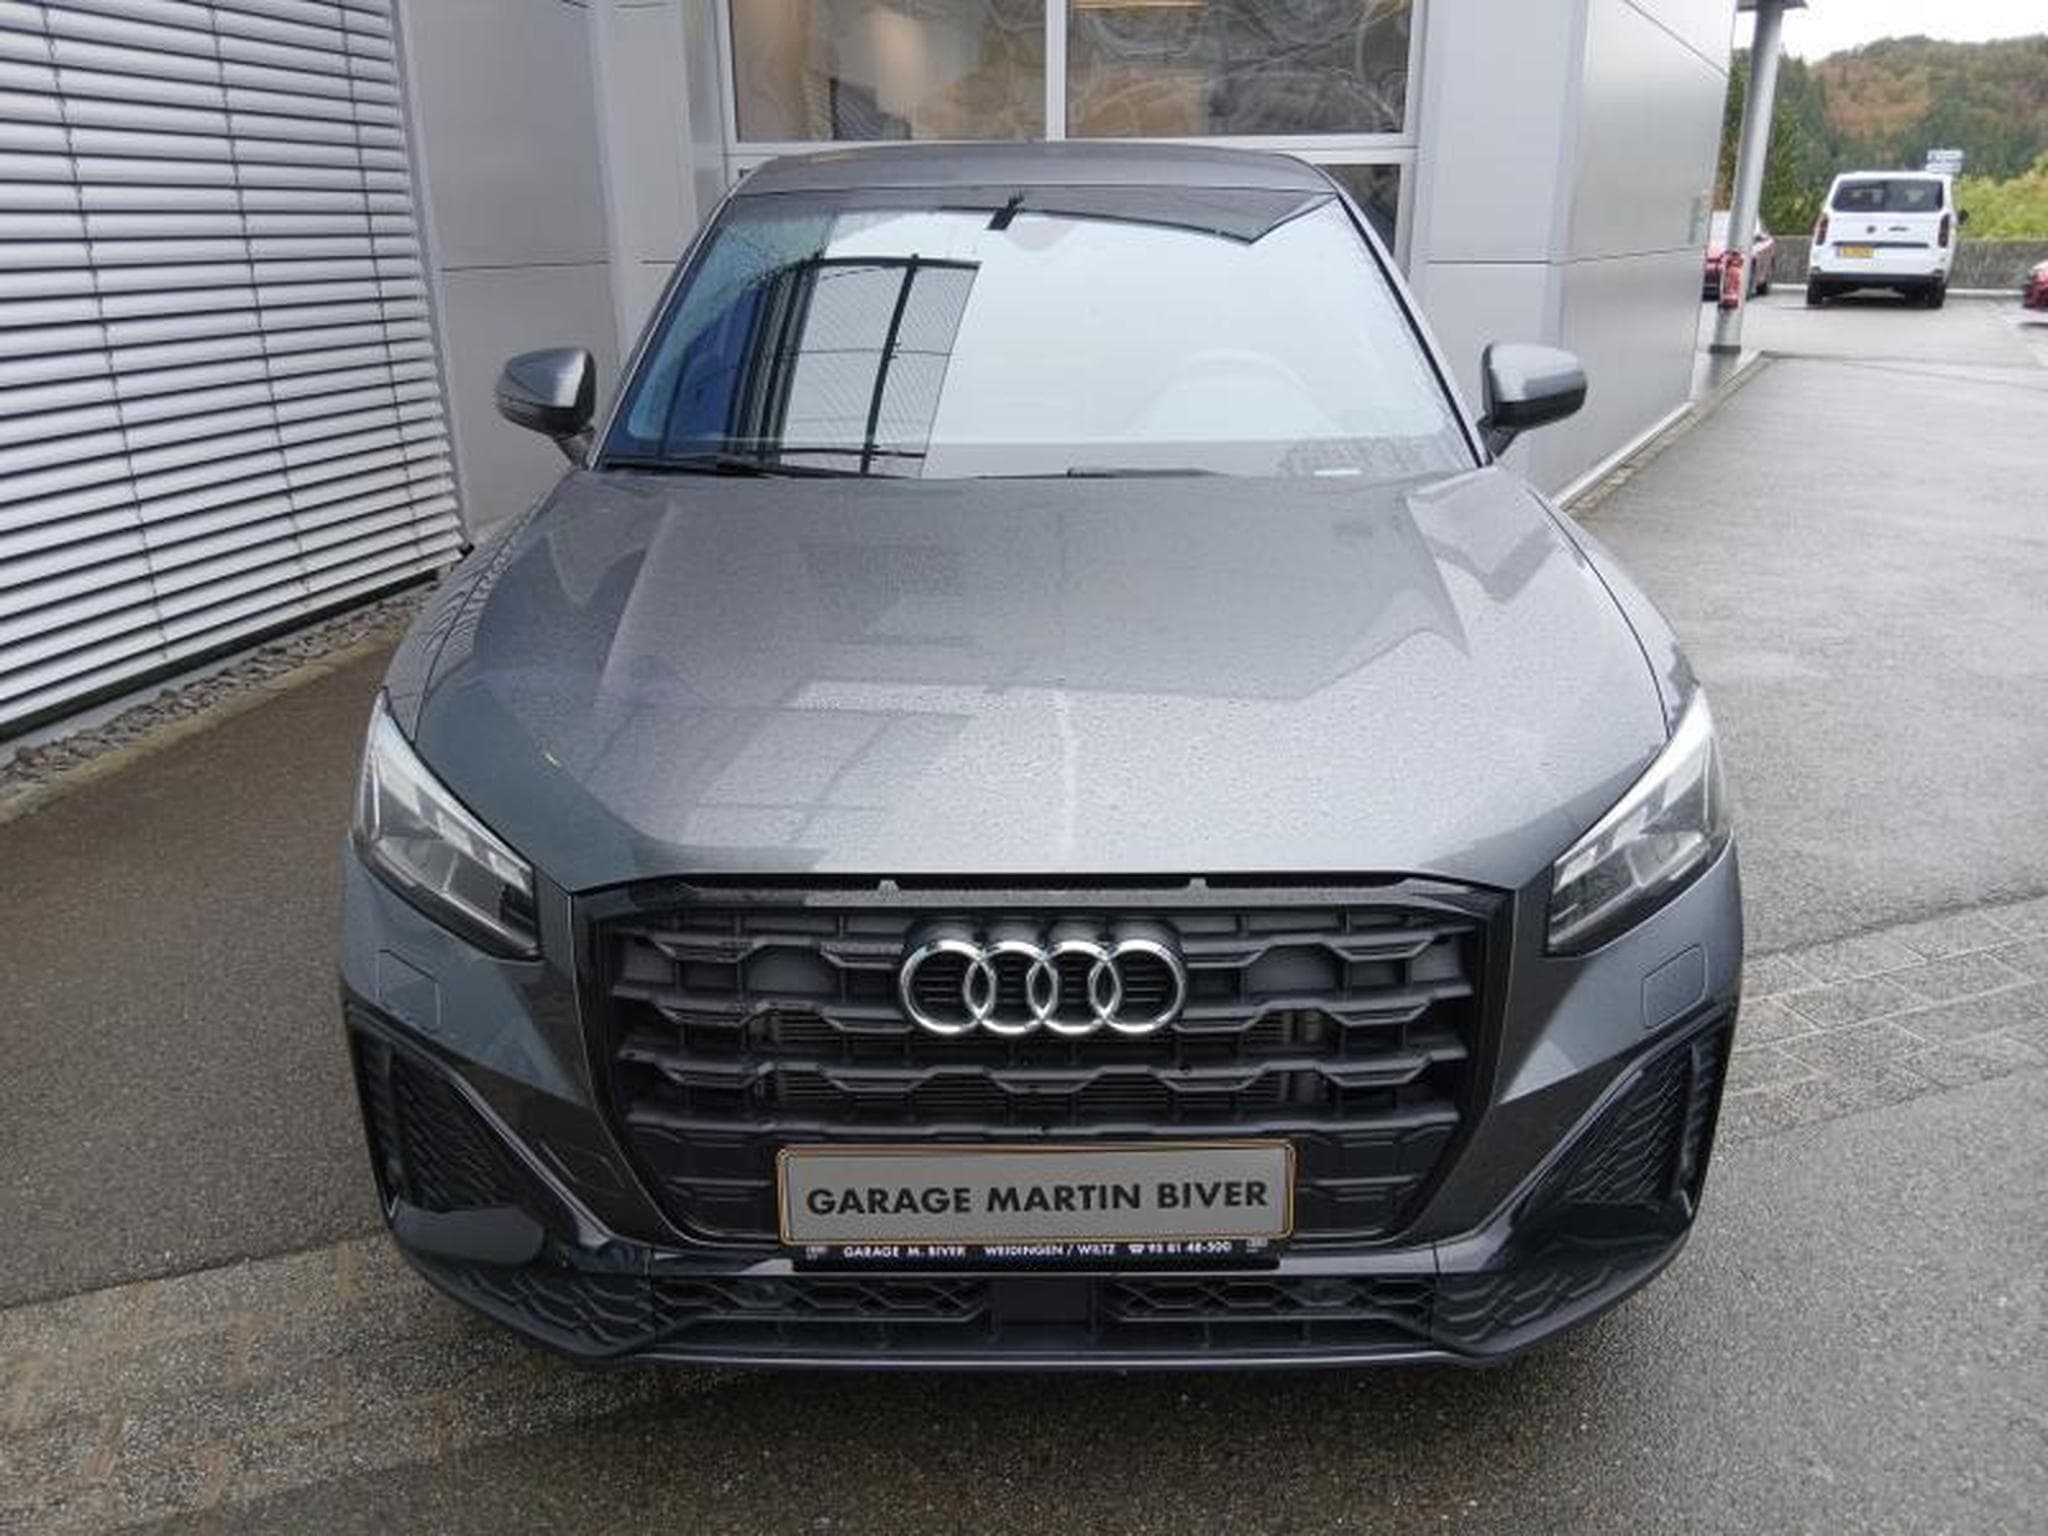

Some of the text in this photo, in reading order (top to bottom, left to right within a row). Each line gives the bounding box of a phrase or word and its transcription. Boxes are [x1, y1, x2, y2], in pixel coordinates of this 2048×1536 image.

[806, 1181, 1267, 1214] GARAGE MARTIN BIVER
[843, 1246, 899, 1257] GARAGE
[928, 1245, 966, 1257] BIVER
